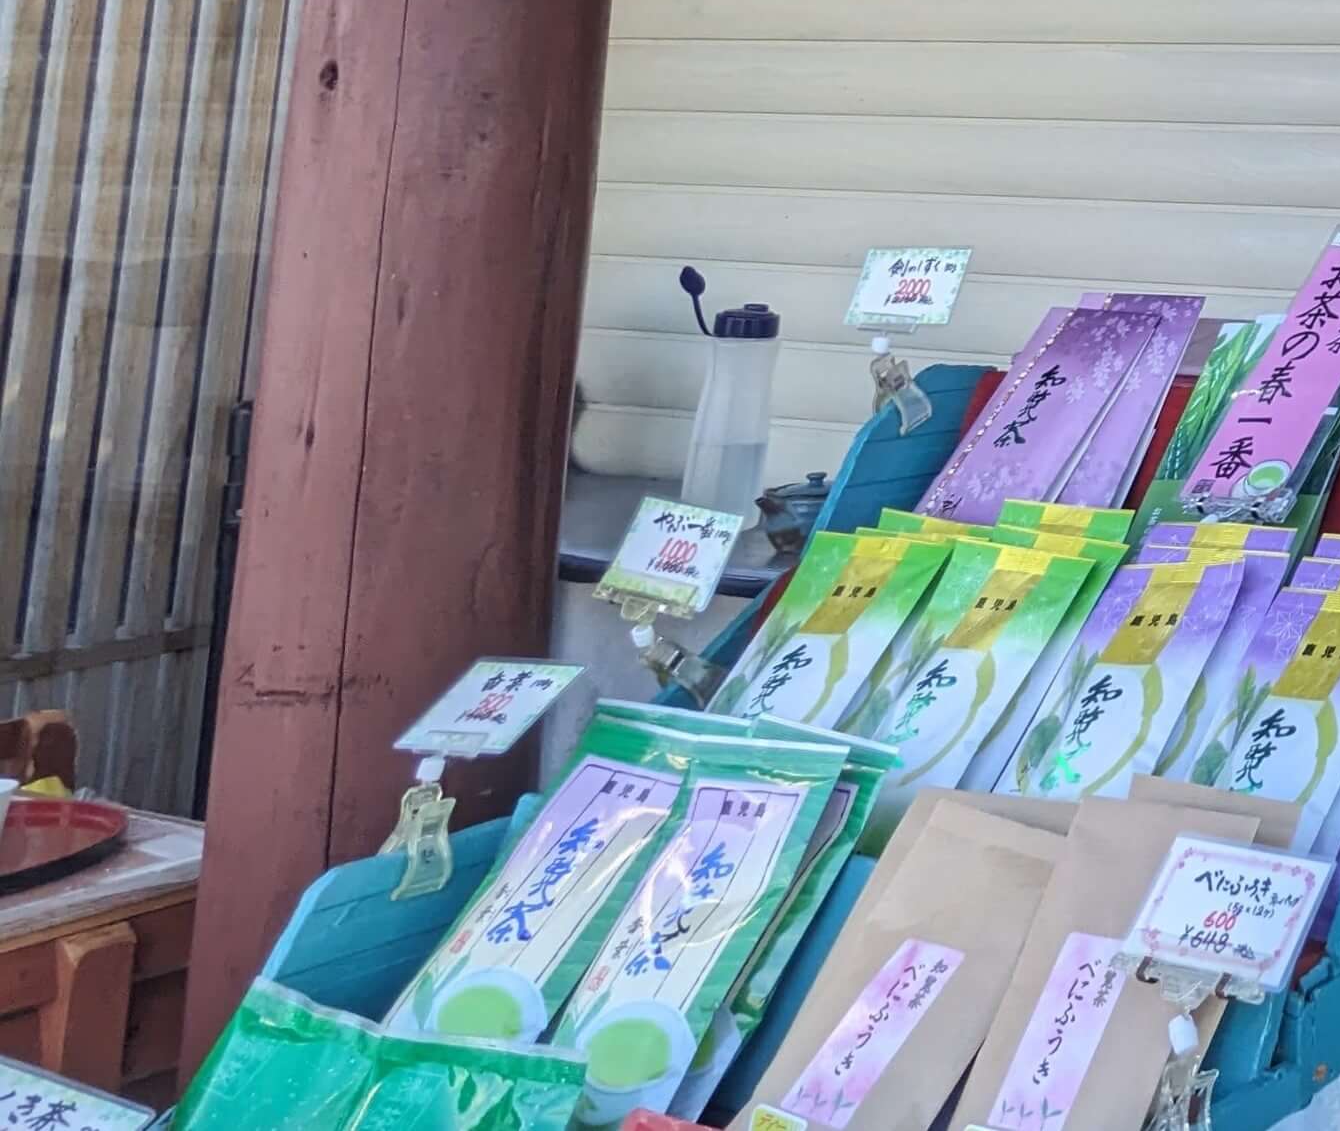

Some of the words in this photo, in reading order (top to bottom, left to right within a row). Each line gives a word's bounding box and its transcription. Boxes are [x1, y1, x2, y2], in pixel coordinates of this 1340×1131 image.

[743, 644, 813, 719] 知覧
[1229, 708, 1297, 794] 知覧
[1203, 910, 1239, 931] 600
